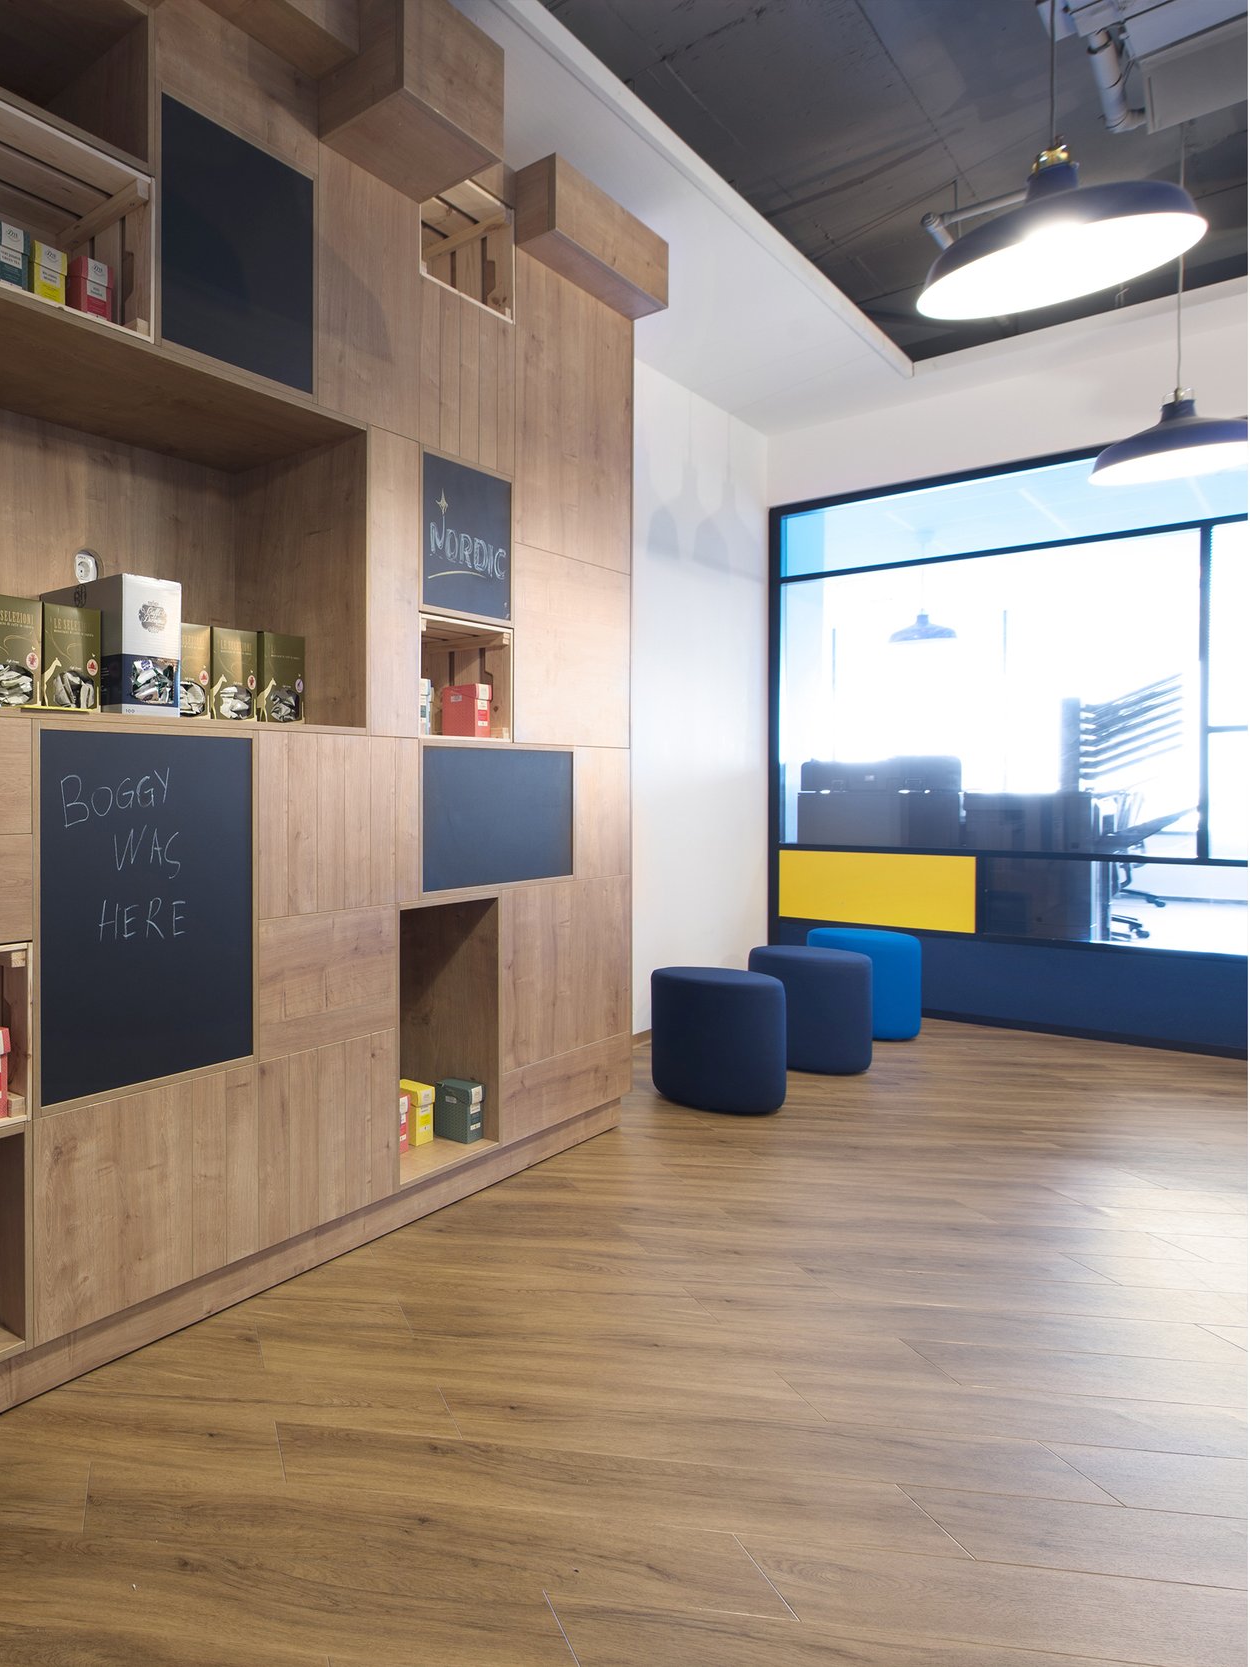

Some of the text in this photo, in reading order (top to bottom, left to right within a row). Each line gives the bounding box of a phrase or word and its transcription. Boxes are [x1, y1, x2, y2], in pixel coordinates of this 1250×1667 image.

[430, 515, 507, 580] NORDIC
[0, 609, 34, 625] SELEZIONI
[60, 767, 170, 829] BOGGY
[114, 824, 181, 880] WAS
[99, 897, 186, 942] HERE
